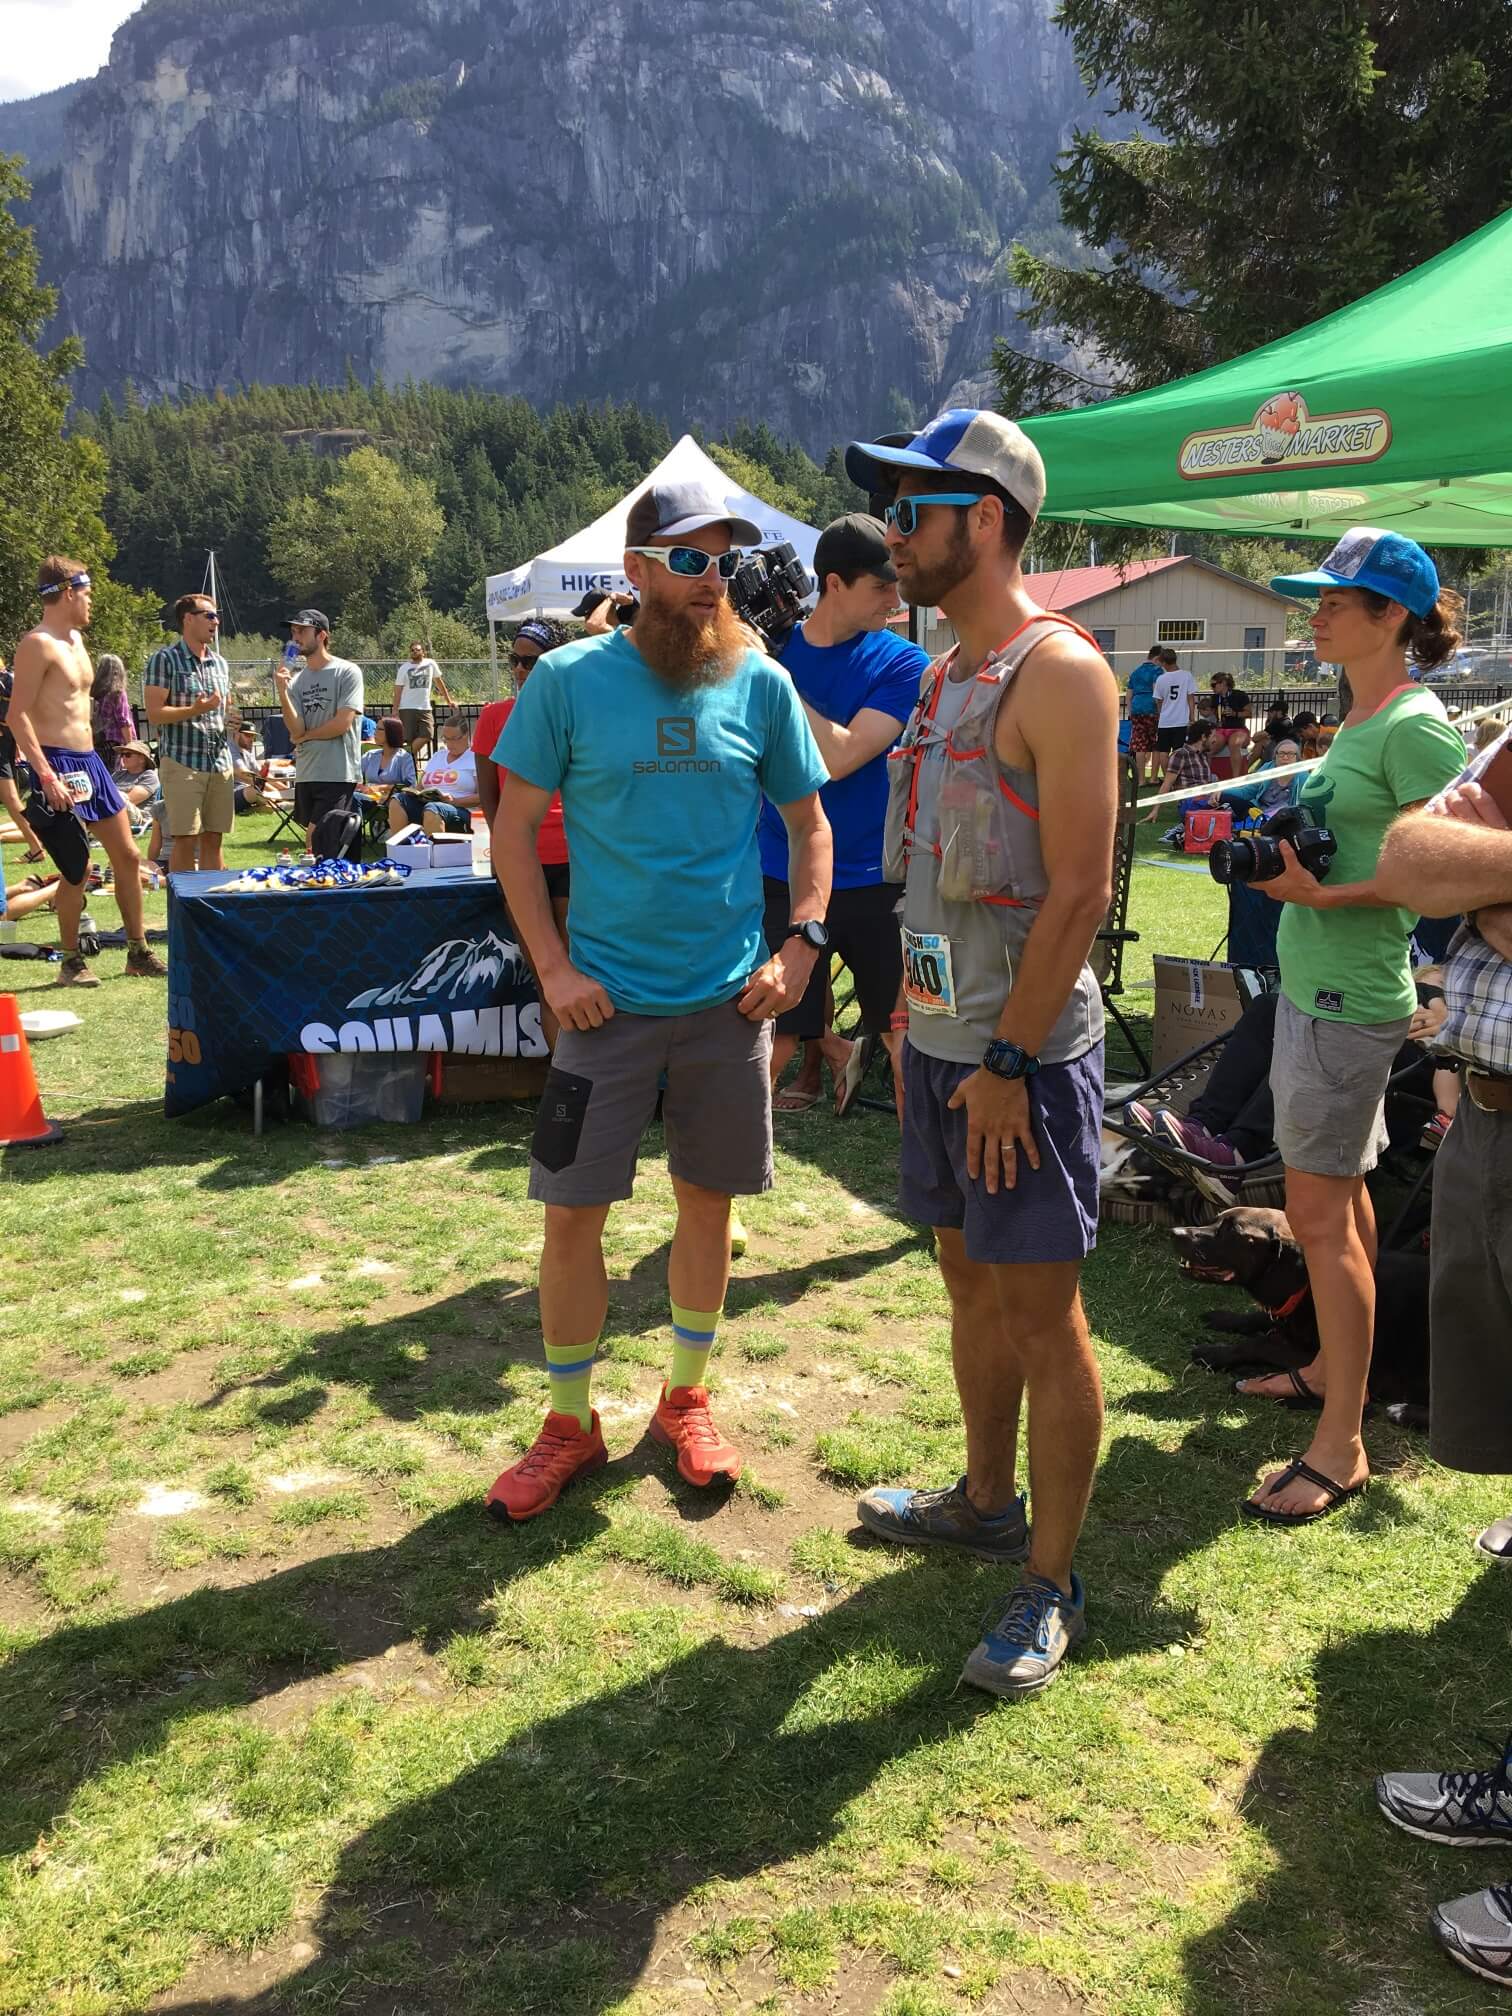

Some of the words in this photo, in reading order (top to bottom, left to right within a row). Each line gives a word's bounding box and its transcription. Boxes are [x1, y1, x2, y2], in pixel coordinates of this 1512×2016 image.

[1183, 436, 1263, 469] NESTERS
[1284, 421, 1384, 457] MARKET
[561, 574, 613, 591] HIKE
[1170, 685, 1180, 700] 5
[660, 720, 692, 753] S
[1171, 1002, 1226, 1020] NOVAS
[168, 1028, 202, 1065] 50
[300, 1002, 550, 1058] SQUAMIS
